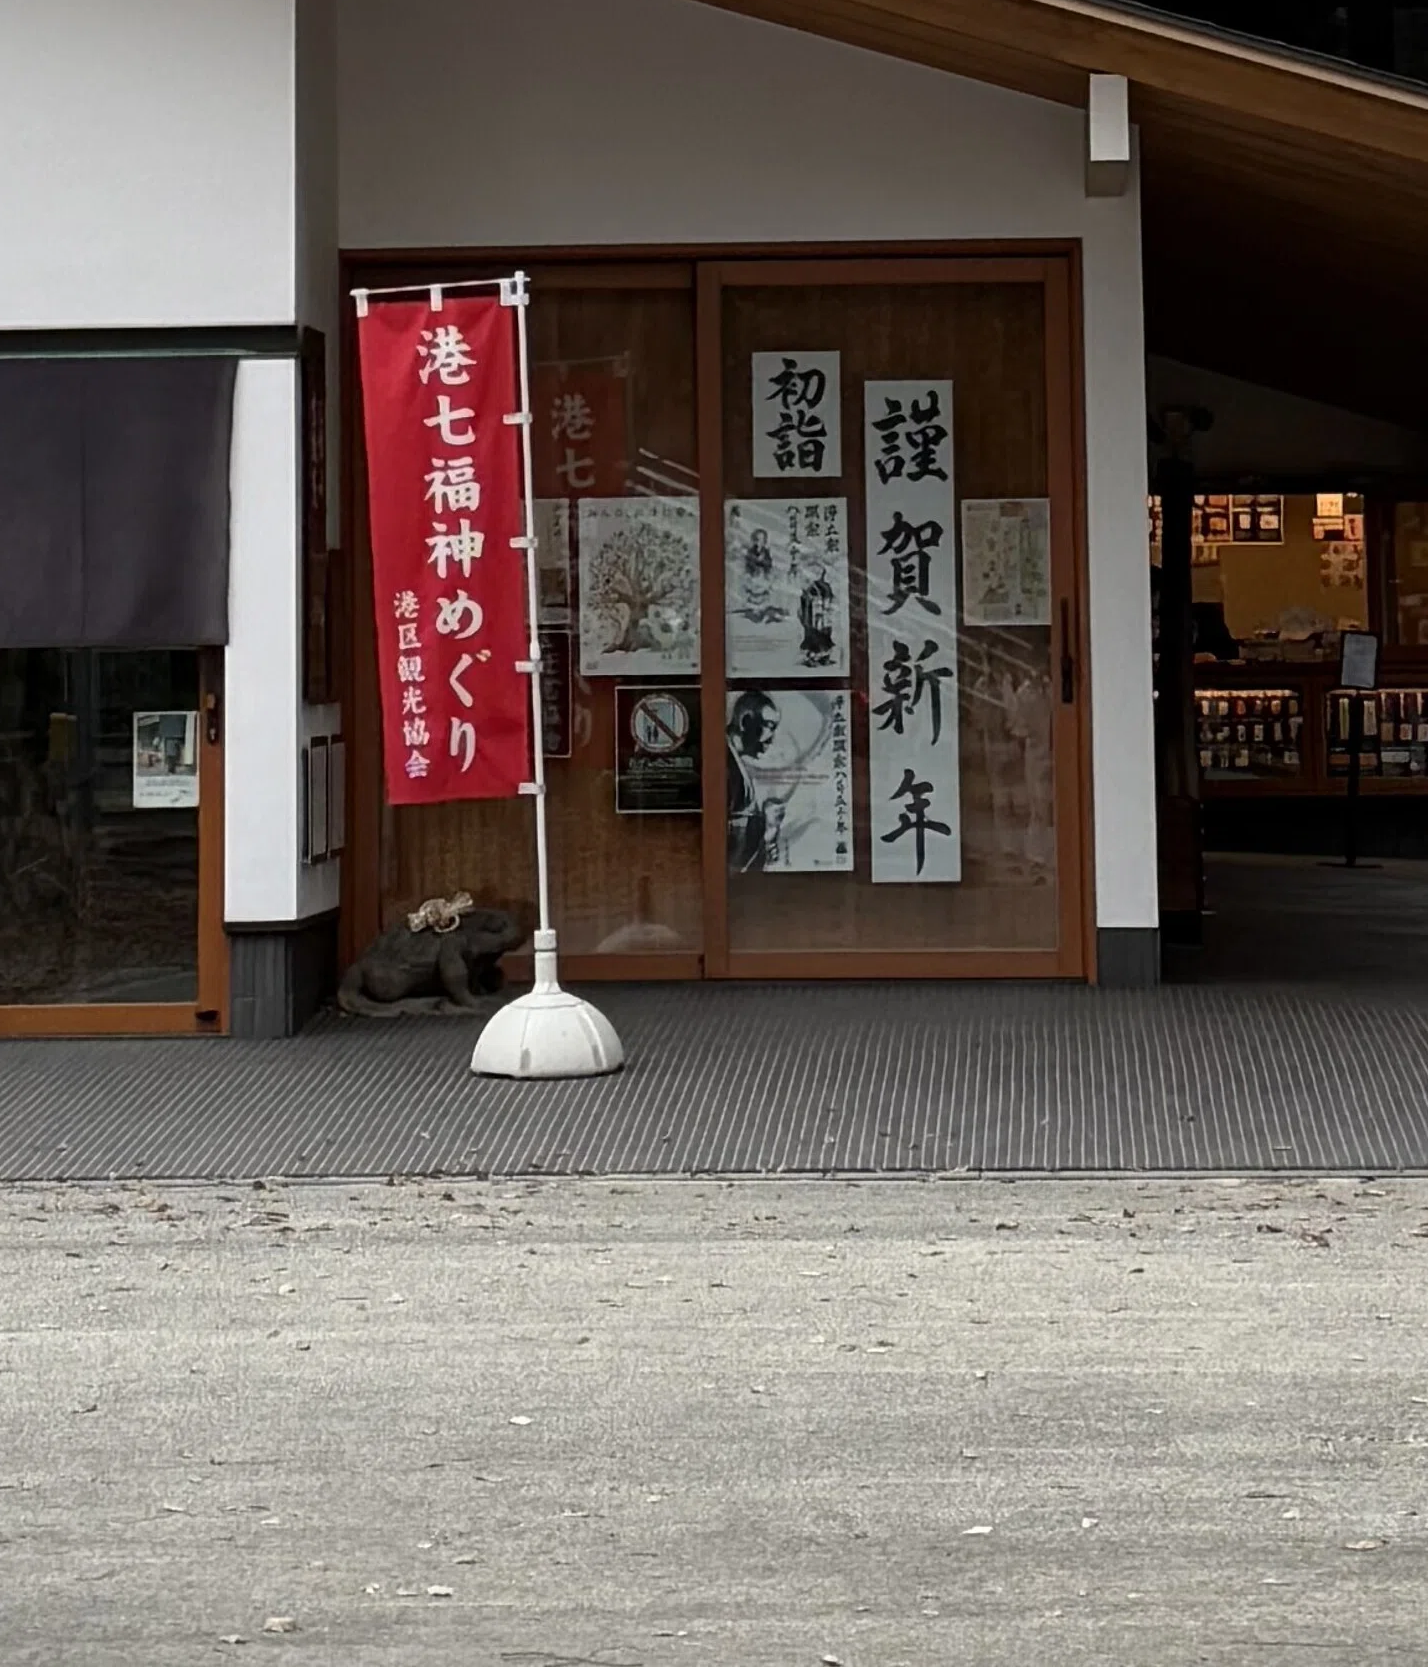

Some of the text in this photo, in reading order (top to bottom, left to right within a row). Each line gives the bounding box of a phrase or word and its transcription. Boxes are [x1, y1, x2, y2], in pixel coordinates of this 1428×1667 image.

[416, 325, 492, 772] 港七福神めぐり
[766, 358, 827, 473] 初詣
[393, 590, 431, 779] 港区観光協会
[871, 390, 953, 875] 謹賀新年
